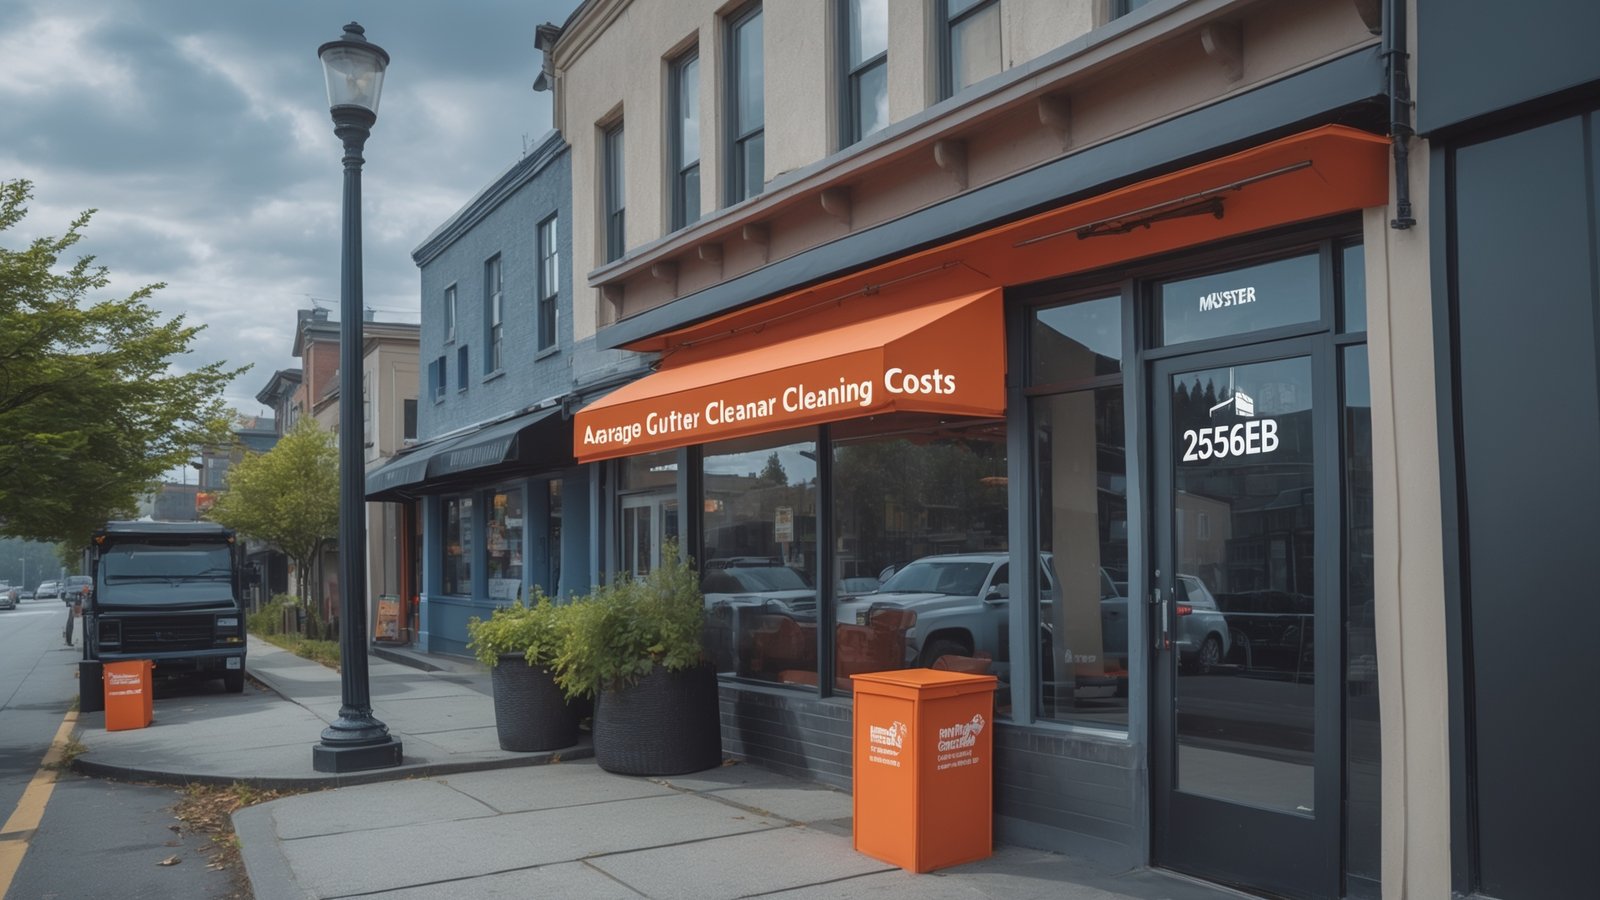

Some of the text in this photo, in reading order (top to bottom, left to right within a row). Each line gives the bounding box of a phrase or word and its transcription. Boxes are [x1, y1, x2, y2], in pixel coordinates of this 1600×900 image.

[705, 397, 777, 425] Cleanar
[782, 377, 873, 412] Cleaning
[884, 367, 956, 395] Costs
[1182, 418, 1280, 462] 2556EB
